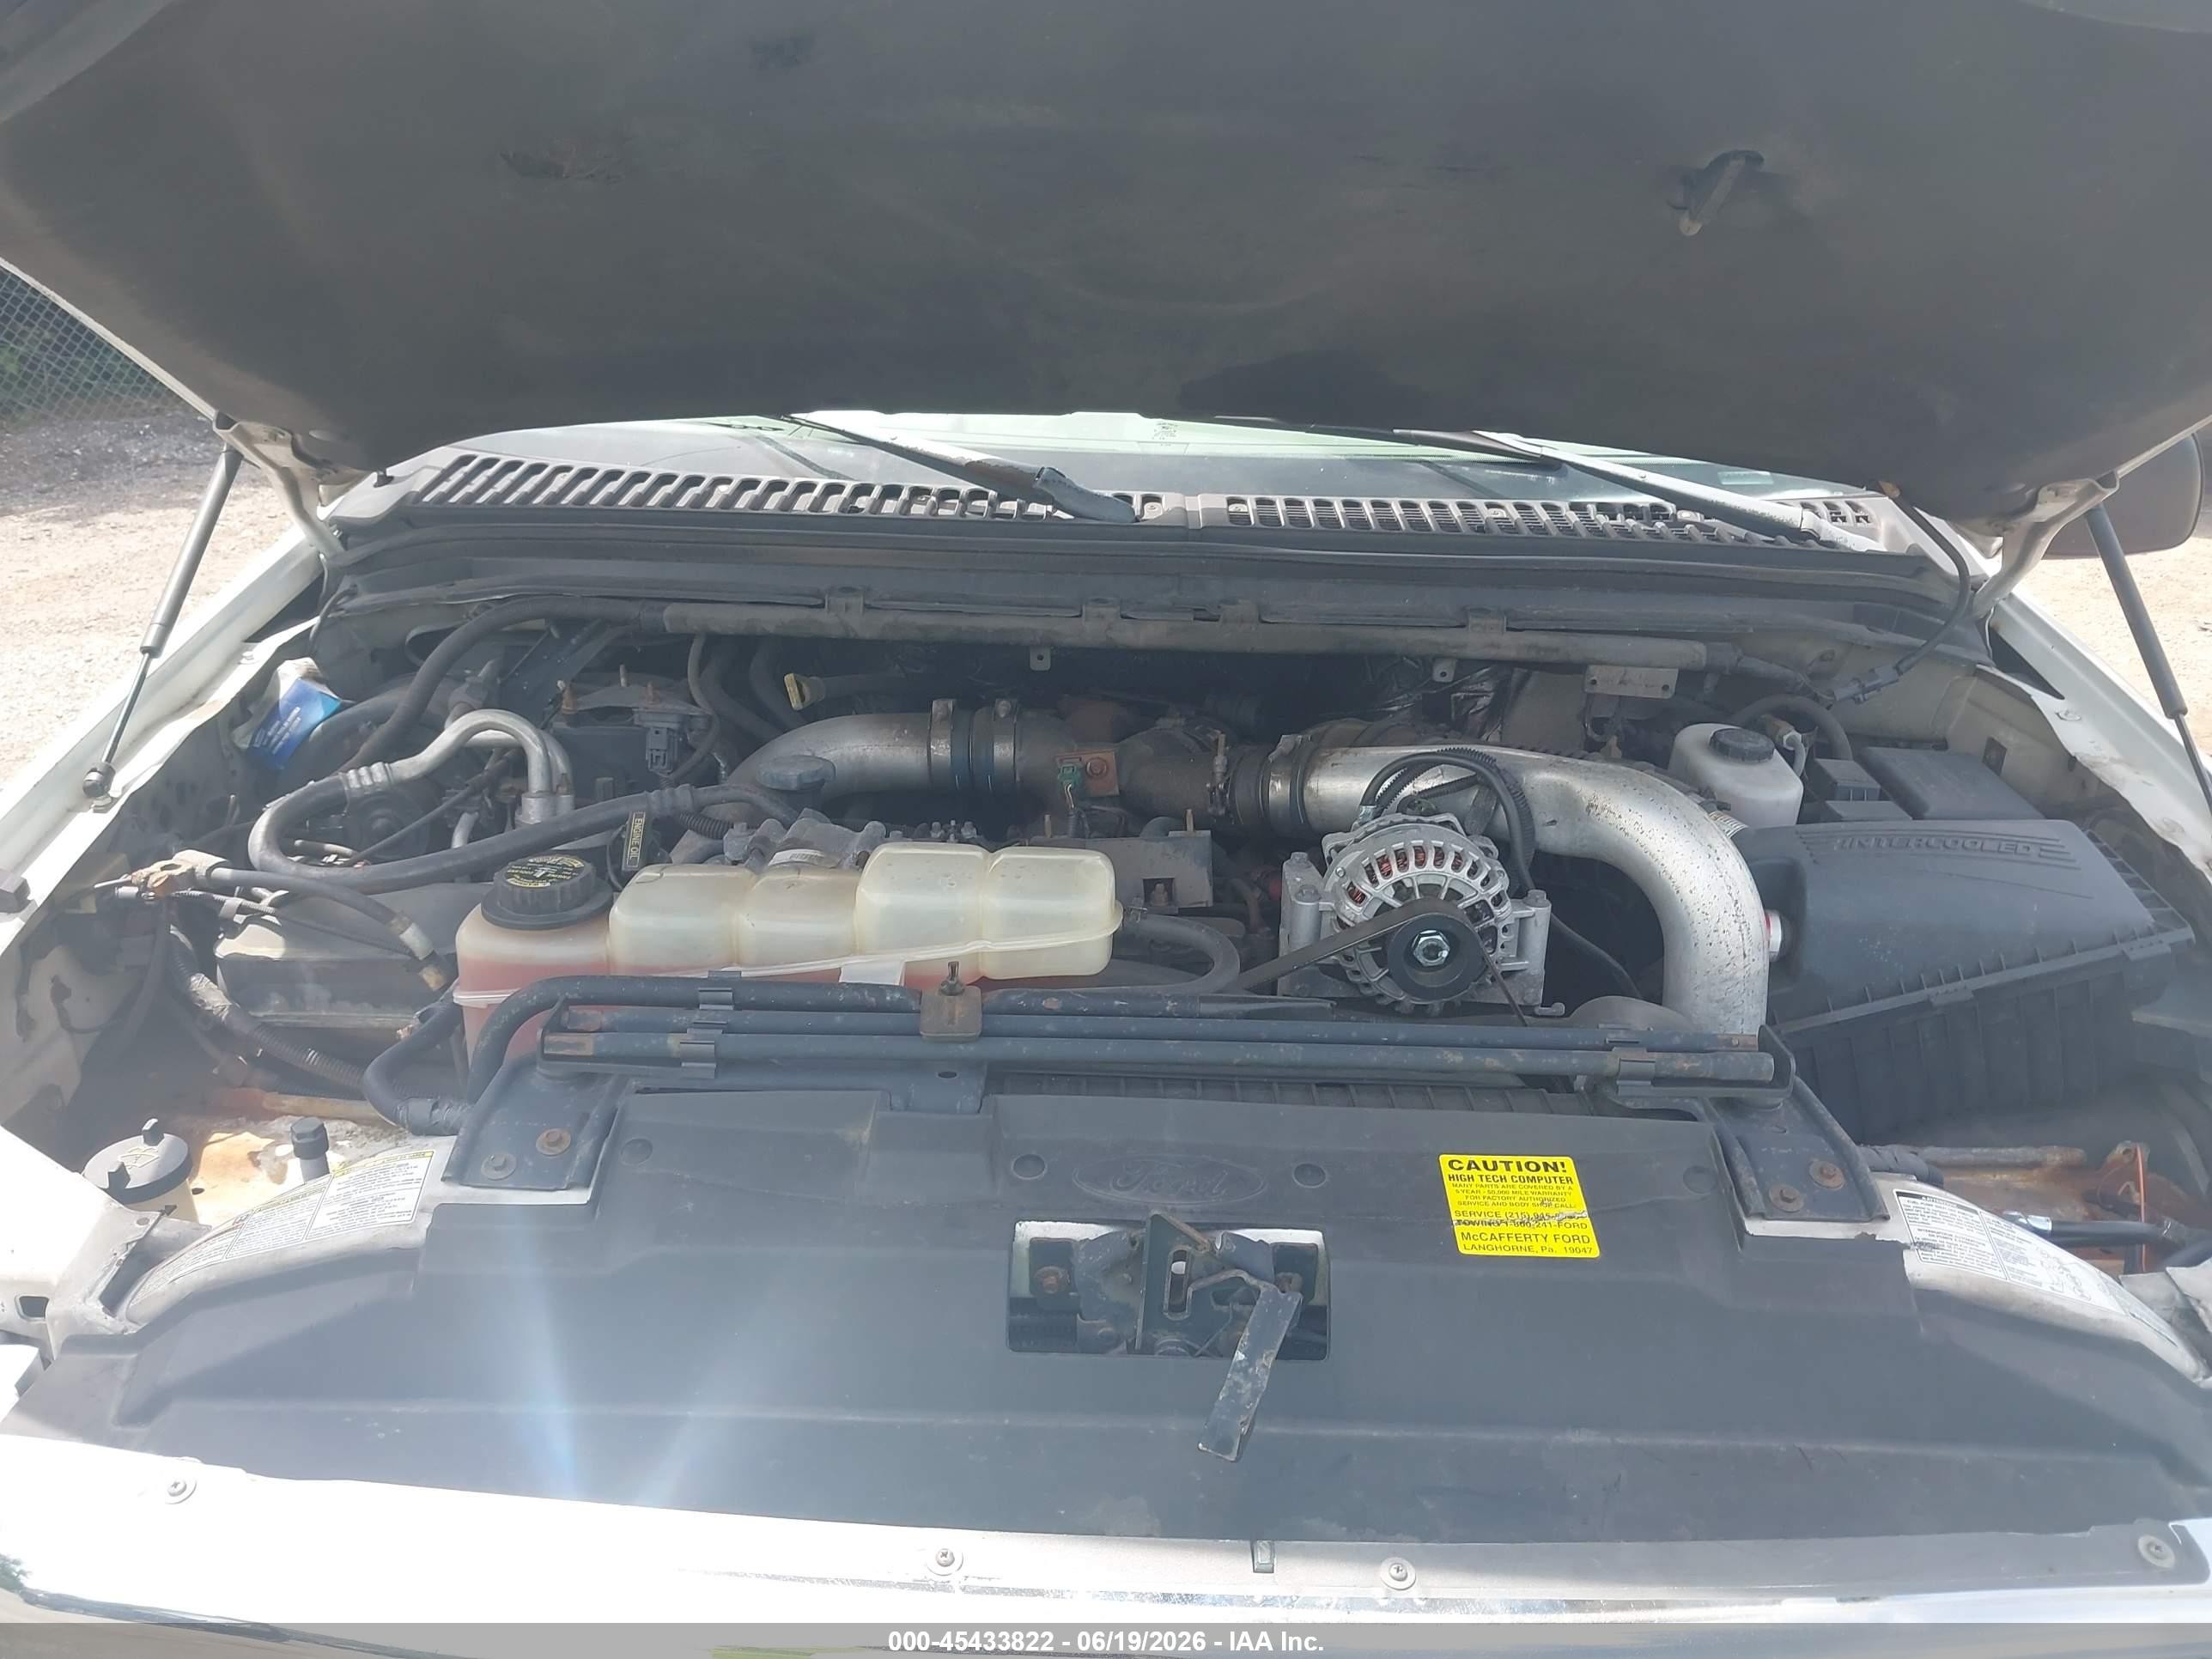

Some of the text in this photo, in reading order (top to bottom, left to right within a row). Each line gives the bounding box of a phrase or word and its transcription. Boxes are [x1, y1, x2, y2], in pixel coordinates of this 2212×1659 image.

[629, 818, 643, 860] ENGINE OIL
[1844, 836, 2033, 856] INTERCOOLED
[1448, 1159, 1566, 1172] CAUTION!
[1448, 1174, 1574, 1184] HIGH TECH COMPUTER
[1461, 1232, 1590, 1243] McCAFFERTY FORD
[1463, 1244, 1538, 1253] LANGHORNE,
